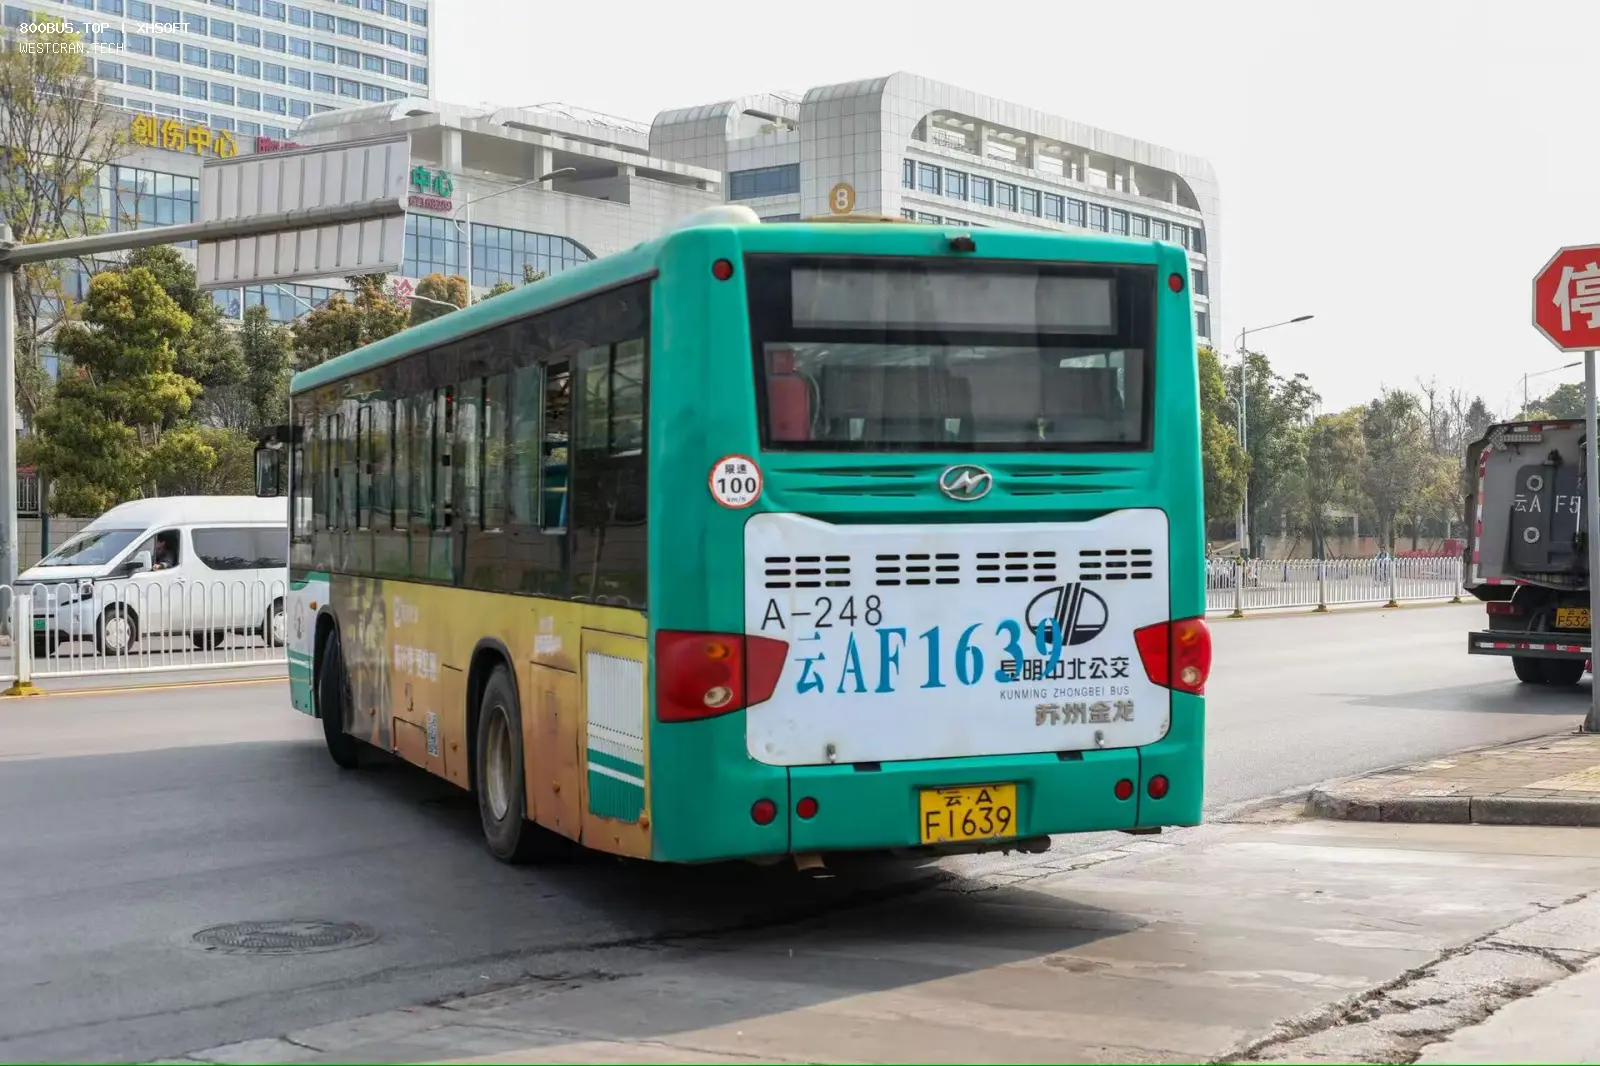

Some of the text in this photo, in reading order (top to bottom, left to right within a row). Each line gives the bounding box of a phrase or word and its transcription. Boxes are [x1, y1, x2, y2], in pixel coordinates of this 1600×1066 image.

[131, 113, 239, 158] 创伤中心
[411, 165, 453, 198] 中心
[835, 188, 849, 210] 8
[724, 463, 748, 475] 限速
[717, 477, 757, 494] 100
[760, 594, 883, 631] A-248
[794, 617, 1062, 694] 云AF1639
[1000, 685, 1130, 700] KUNMING ZHONGBEI BUS
[1034, 700, 1135, 727] 苏州金龙
[926, 805, 1012, 840] F1639
